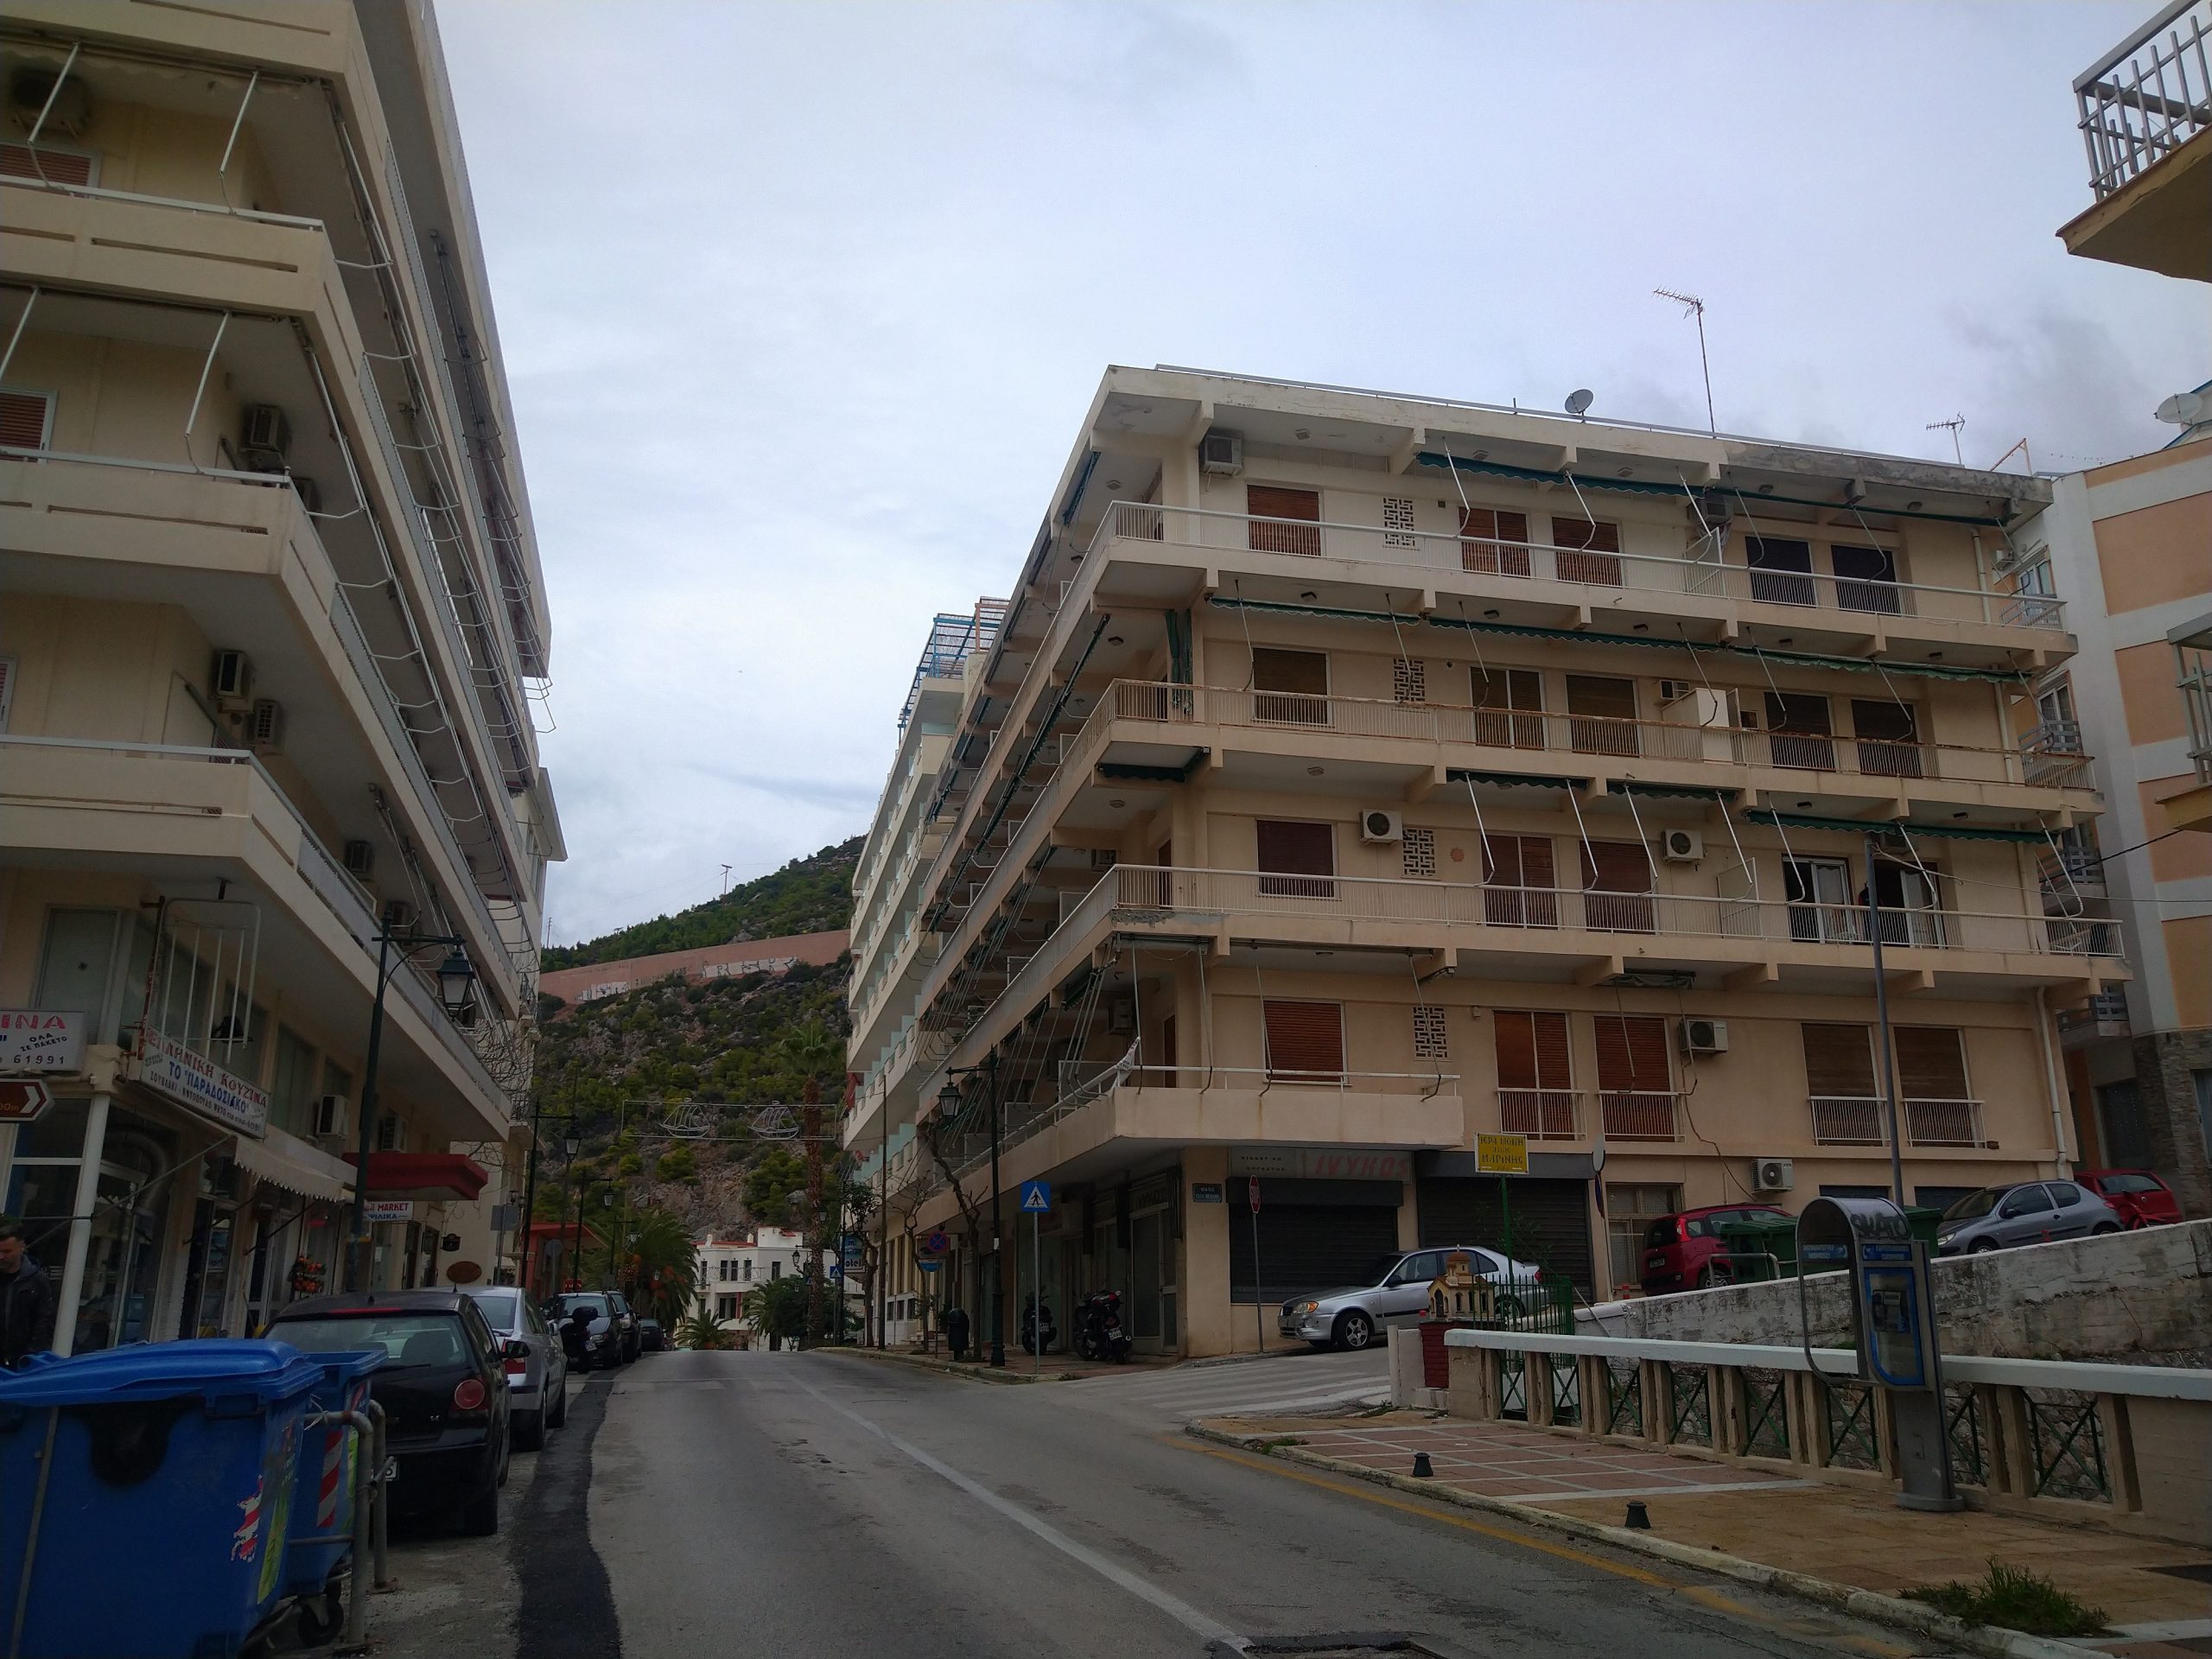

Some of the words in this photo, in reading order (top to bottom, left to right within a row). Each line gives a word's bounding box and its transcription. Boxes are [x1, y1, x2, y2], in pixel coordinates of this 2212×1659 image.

[35, 1036, 68, 1048] ΠΑΚΕΤΟ
[14, 1054, 65, 1065] 61991
[168, 1061, 181, 1080] ΤΟ
[220, 1073, 267, 1108] ΚΟΥΖΙΝΑ
[378, 1203, 409, 1212] MARKET
